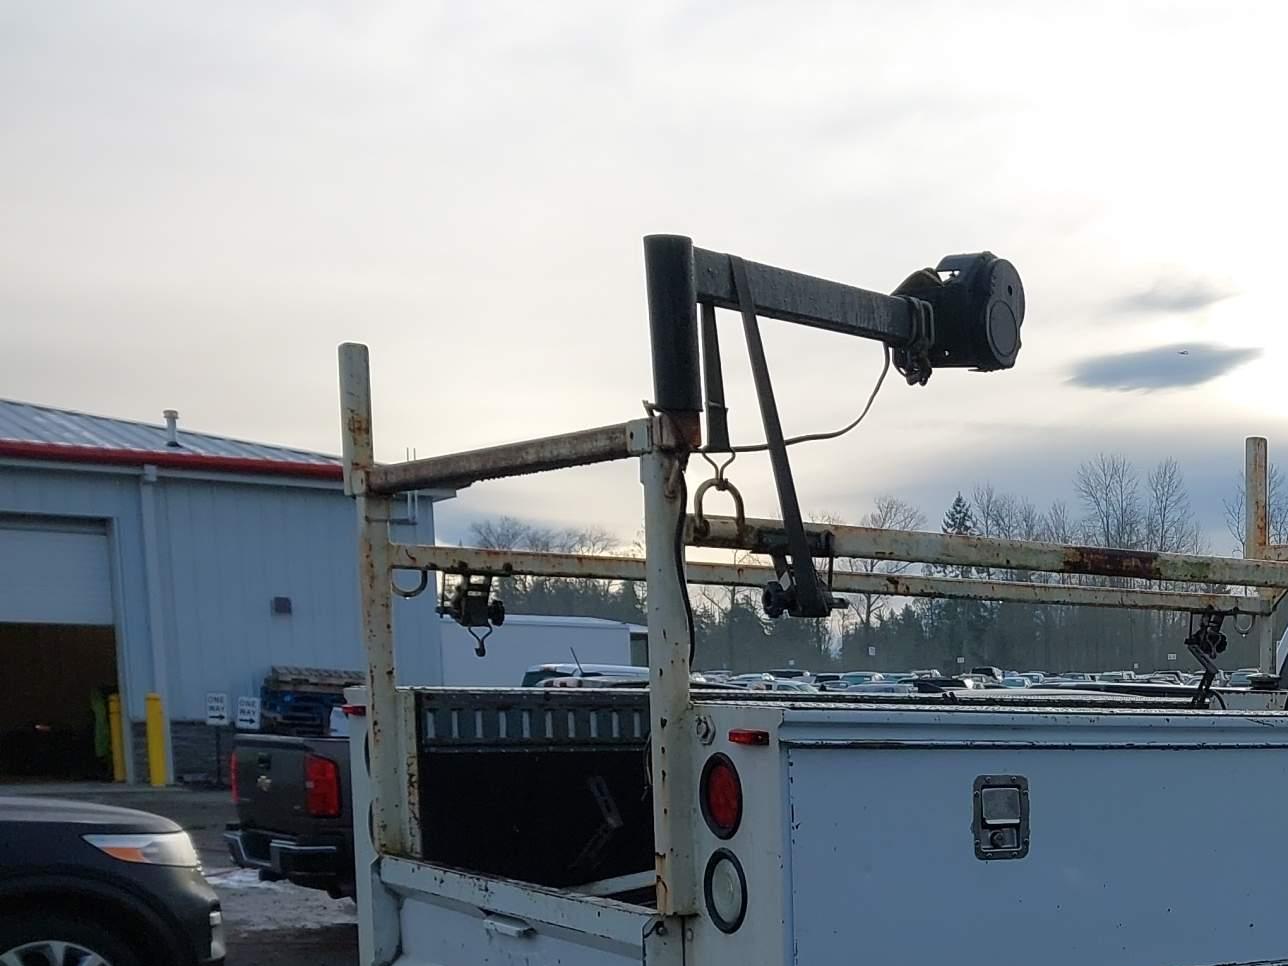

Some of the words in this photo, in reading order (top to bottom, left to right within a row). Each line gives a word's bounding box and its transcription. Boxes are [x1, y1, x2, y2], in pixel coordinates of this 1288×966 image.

[207, 695, 225, 704] ONE
[208, 704, 225, 712] WAY
[239, 708, 257, 716] WAY
